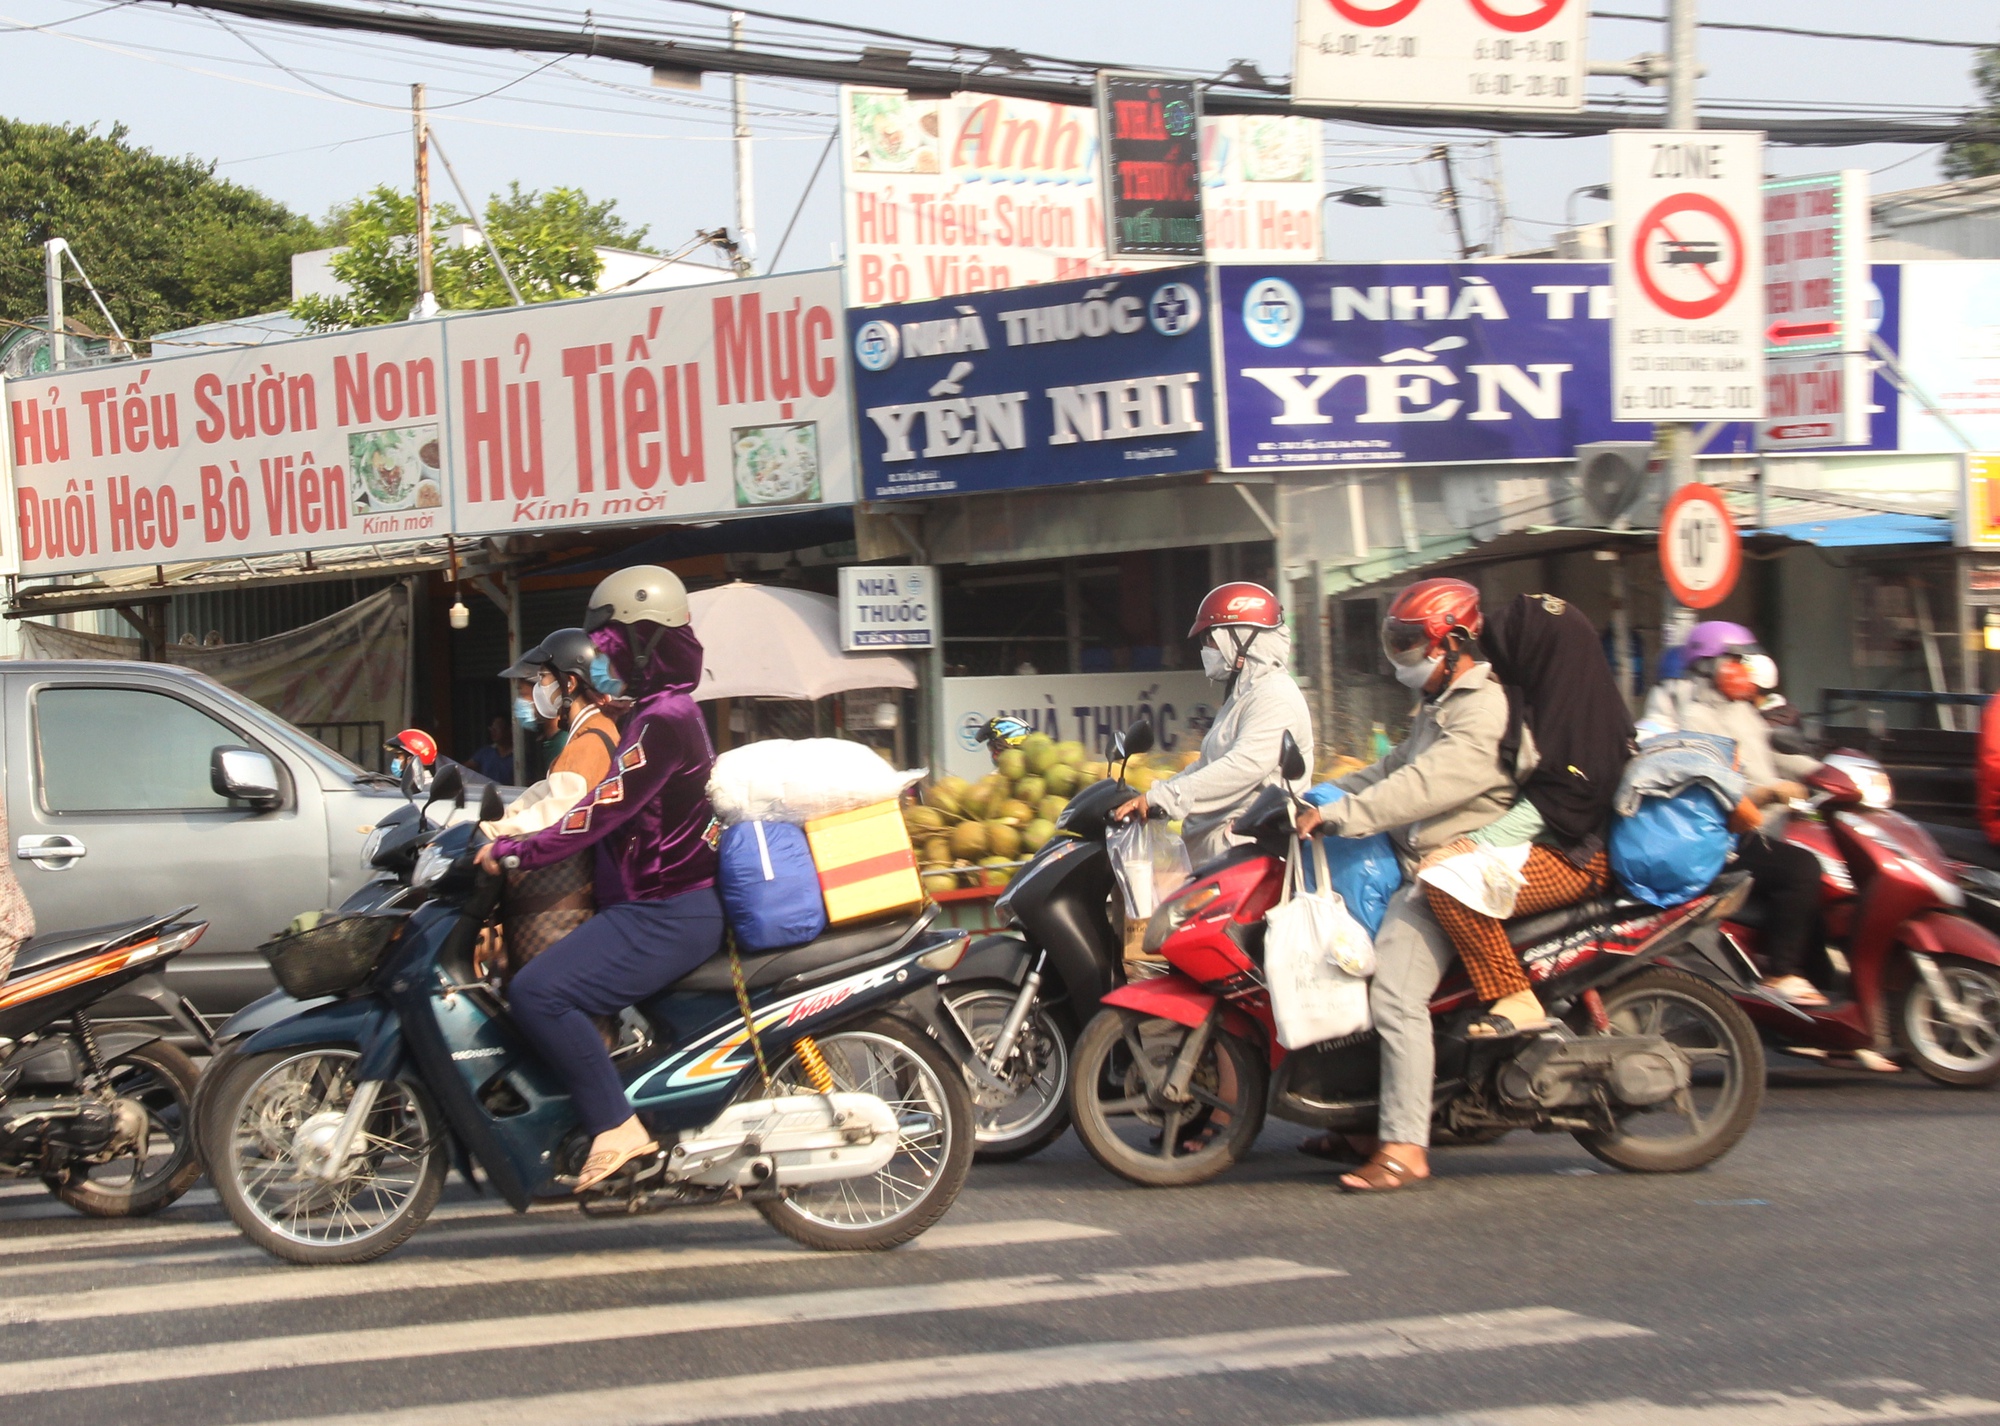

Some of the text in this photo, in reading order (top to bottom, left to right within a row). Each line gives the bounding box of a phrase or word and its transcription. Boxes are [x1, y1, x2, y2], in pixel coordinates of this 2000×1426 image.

[951, 97, 1084, 172] Anh
[1113, 88, 1169, 140] NHÀ
[1118, 143, 1197, 201] THUỐC
[1650, 143, 1723, 179] ZONE
[857, 184, 897, 245] Hủ
[994, 190, 1074, 248] Sườn
[1121, 207, 1163, 242] YẾN
[1258, 199, 1314, 250] Heo
[860, 254, 911, 304] Bò
[1331, 276, 1509, 321] NHÀ
[901, 281, 1145, 359] NHÀ THUỐC
[461, 292, 836, 503] Hủ Tiếu Mực
[1240, 335, 1573, 425] YẾN
[1622, 386, 1753, 409] 6:00-22:00
[11, 352, 437, 466] Hủ Tiếu Sườn Non
[866, 361, 1203, 462] YẾN NHI
[18, 478, 98, 561] Đuôi
[260, 451, 347, 536] Viên
[363, 512, 434, 535] Kính mời
[512, 490, 668, 522] Kính mời
[857, 574, 899, 596] NHÀ
[857, 597, 927, 622] THUỐC
[1227, 597, 1266, 612] GP
[787, 985, 857, 1027] Wave
